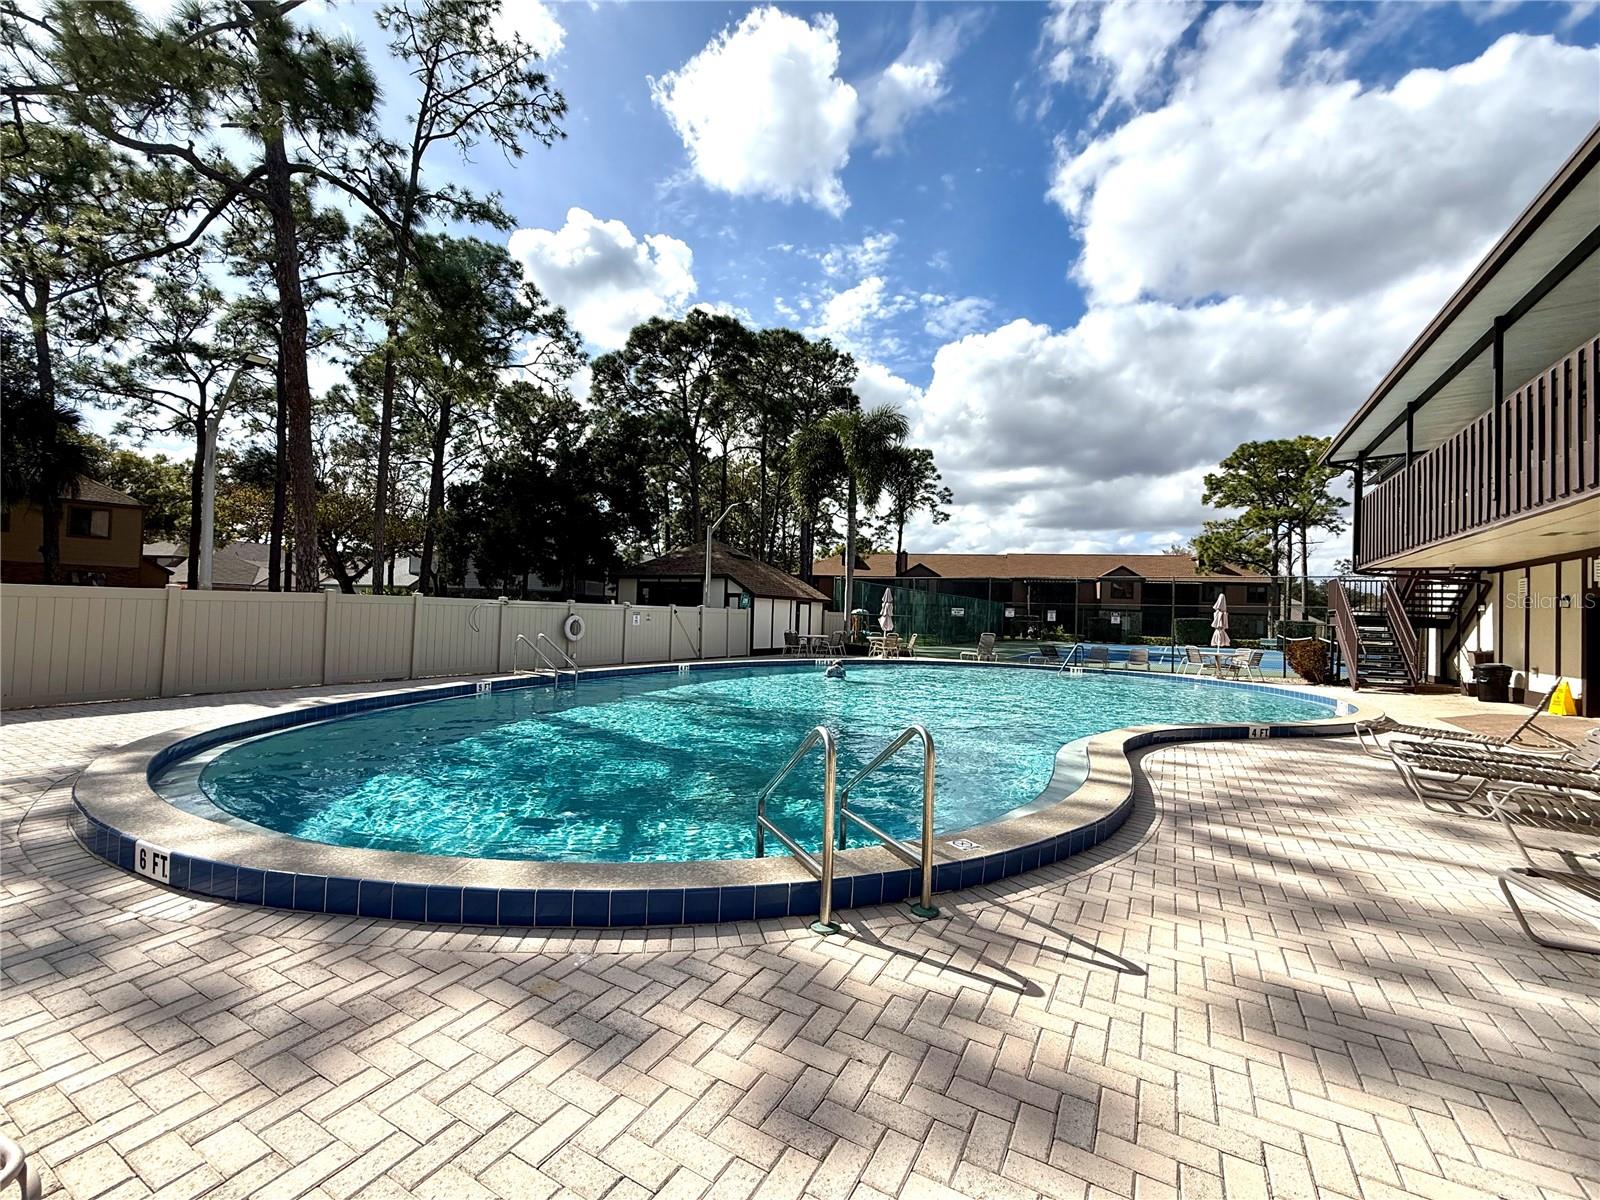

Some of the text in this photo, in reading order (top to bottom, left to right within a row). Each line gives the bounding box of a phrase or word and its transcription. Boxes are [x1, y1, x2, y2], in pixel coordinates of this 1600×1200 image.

[1251, 728, 1256, 737] 4
[140, 848, 168, 878] 6 FT.
